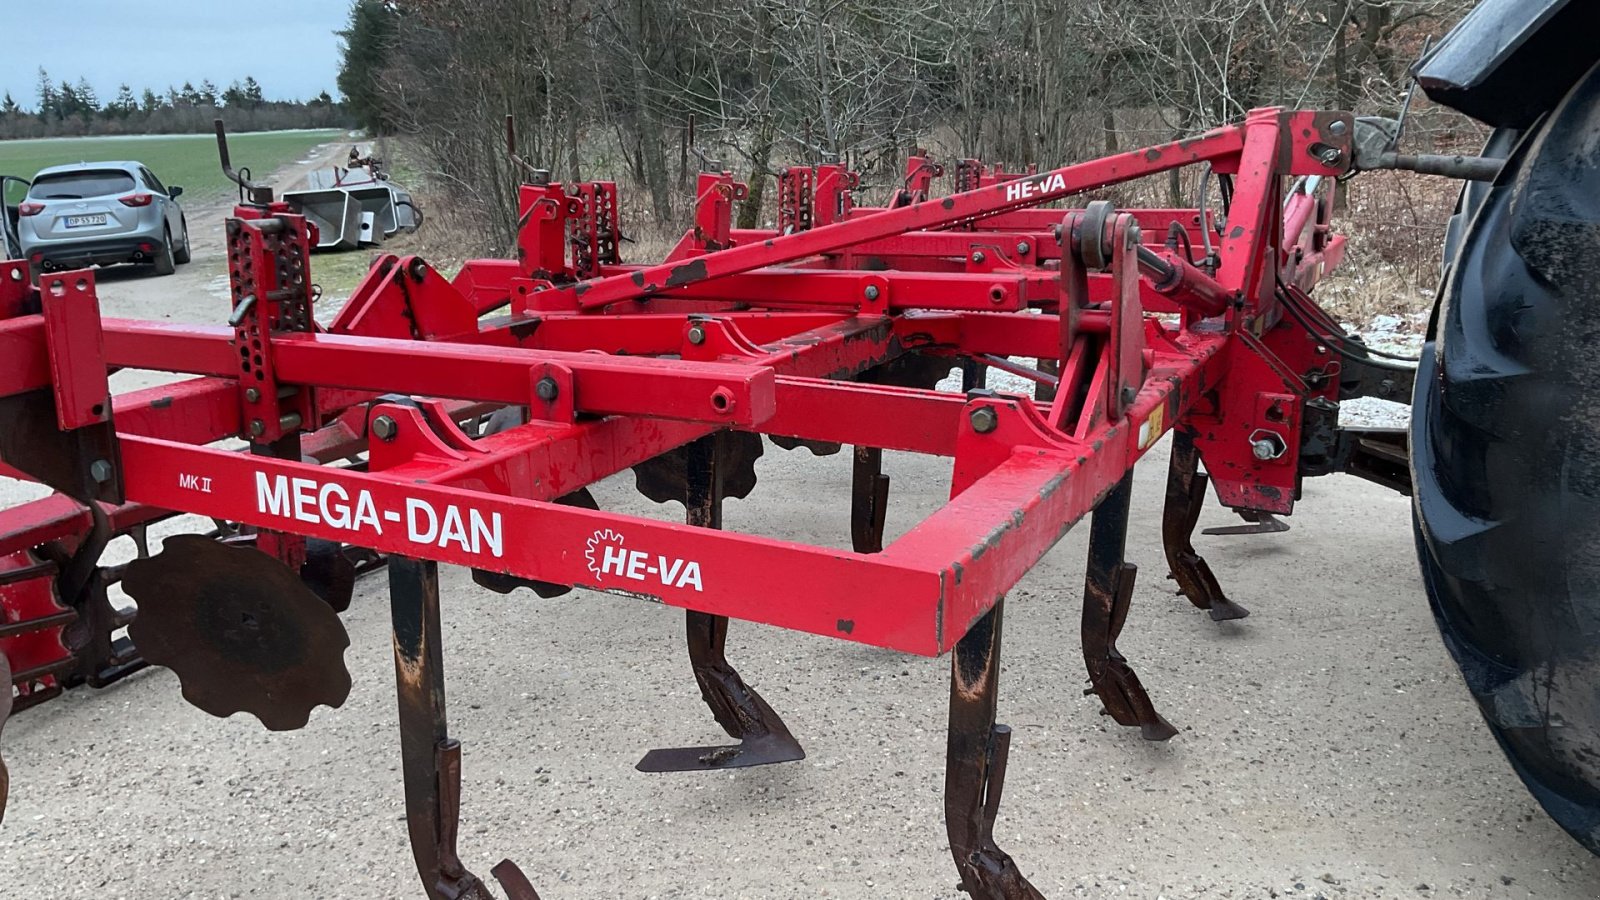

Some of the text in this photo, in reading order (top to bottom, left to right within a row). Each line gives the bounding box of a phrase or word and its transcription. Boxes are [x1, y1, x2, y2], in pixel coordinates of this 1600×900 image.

[1007, 174, 1066, 202] HE-VA
[69, 217, 79, 225] DP
[92, 215, 105, 223] 720
[179, 473, 199, 491] MK
[255, 470, 504, 557] MEGA-DAN
[602, 544, 704, 592] HE-VA
